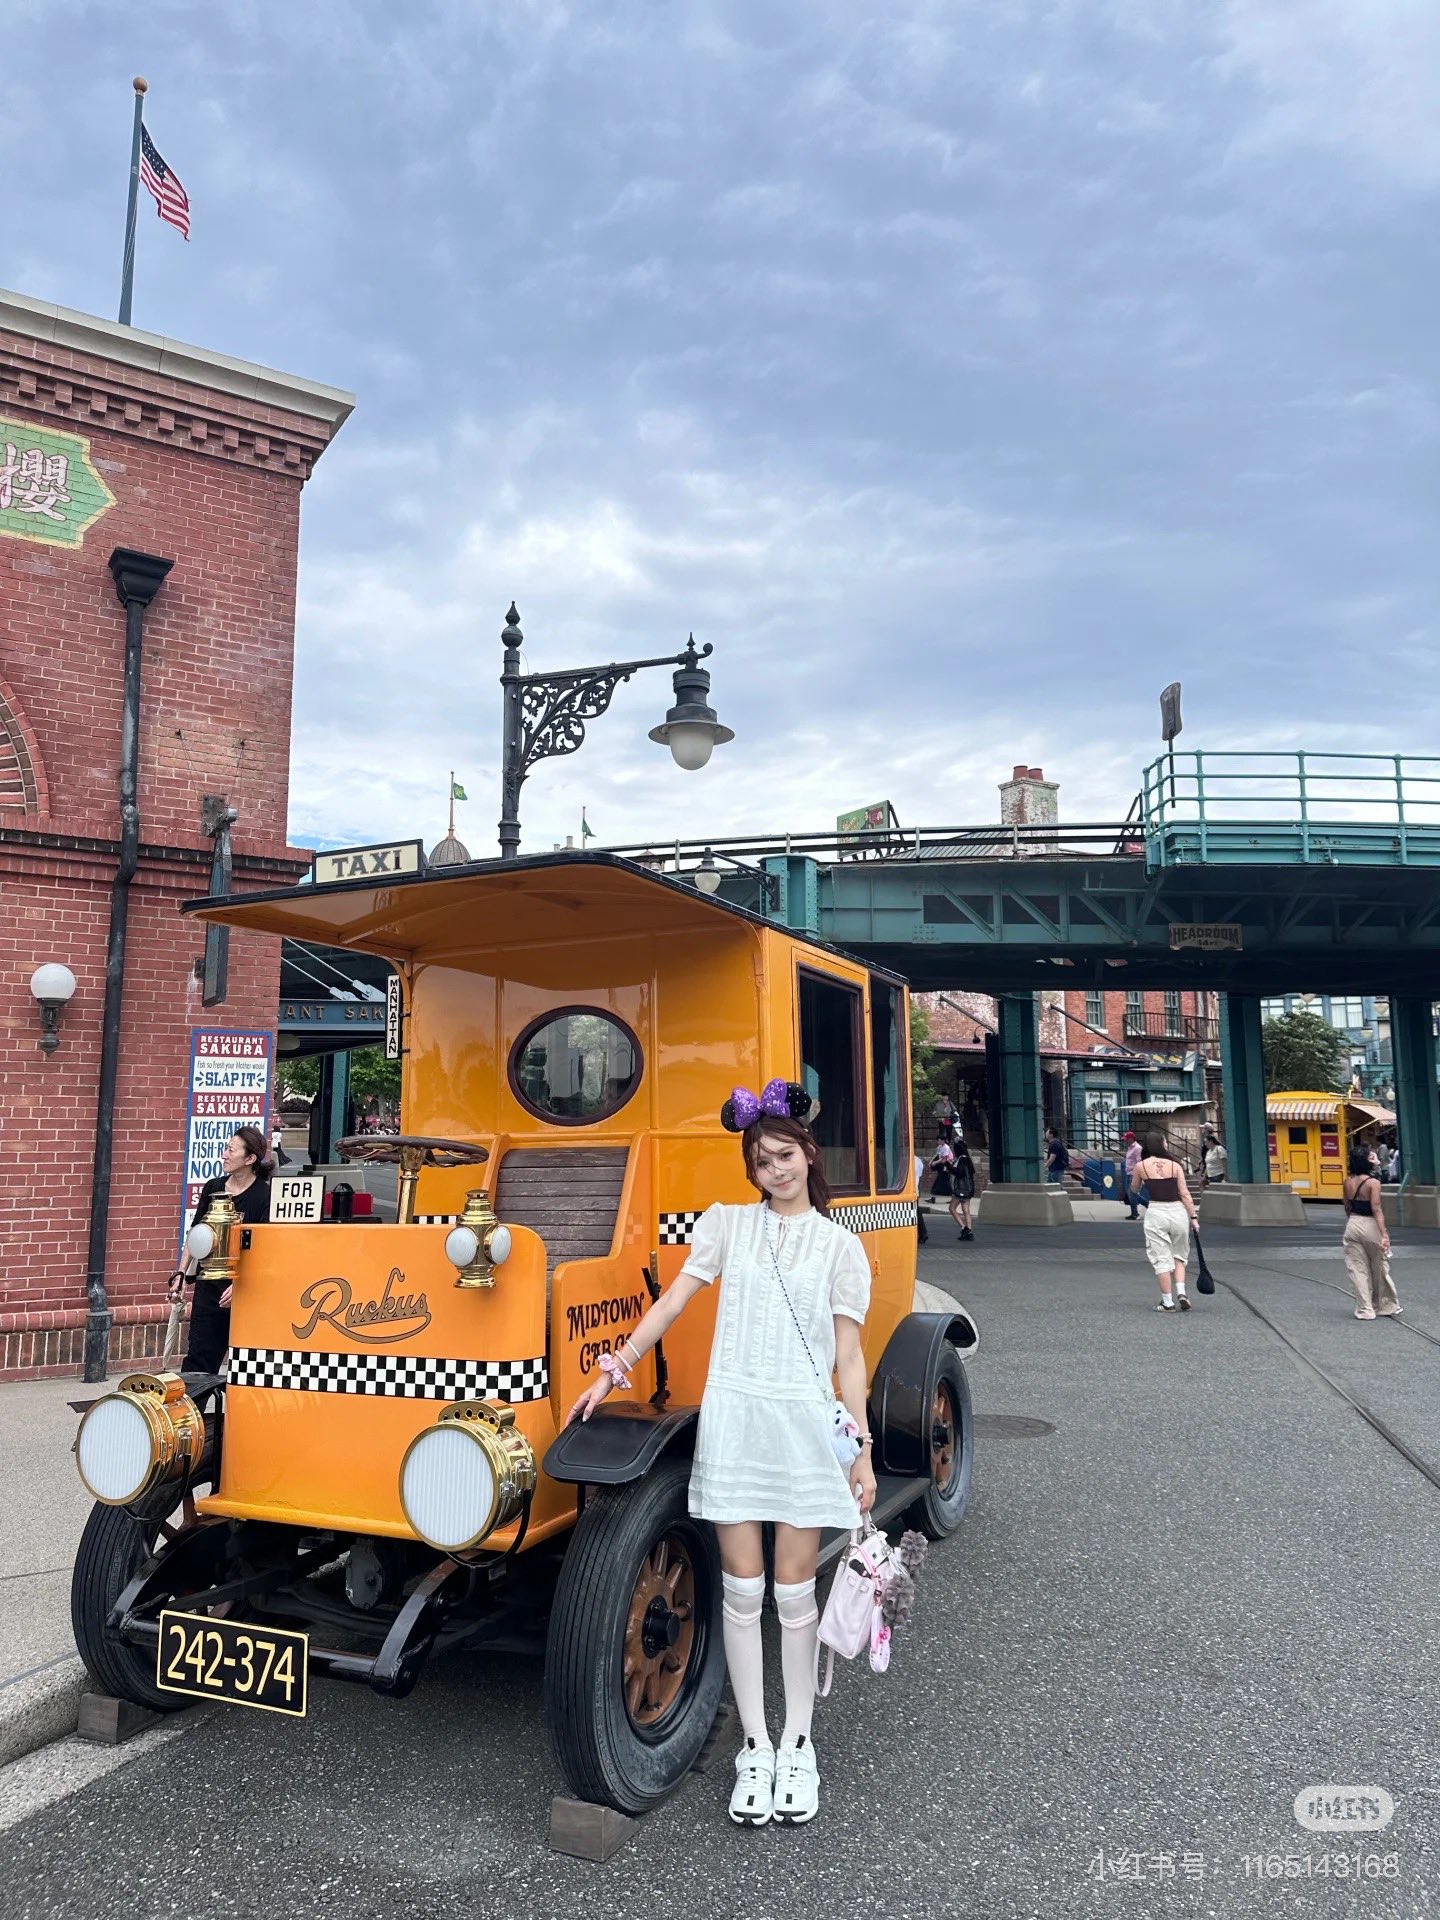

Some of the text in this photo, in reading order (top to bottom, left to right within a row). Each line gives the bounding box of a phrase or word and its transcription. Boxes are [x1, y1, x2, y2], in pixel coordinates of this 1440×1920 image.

[332, 849, 402, 878] TAXI
[1171, 927, 1240, 945] HEADROOM
[388, 979, 398, 1054] MANHATTAN
[201, 1035, 264, 1045] RESTAURANT
[200, 1043, 263, 1055] SAKURA
[205, 1071, 256, 1087] SLAP IT
[197, 1095, 261, 1103] RESTAURANT
[196, 1103, 260, 1114] SAKURA
[282, 1182, 312, 1198] FOR
[276, 1202, 315, 1218] HIRE
[291, 1267, 432, 1344] Ruckus
[566, 1292, 645, 1341] MIDTOWN
[167, 1625, 295, 1701] 242-374
